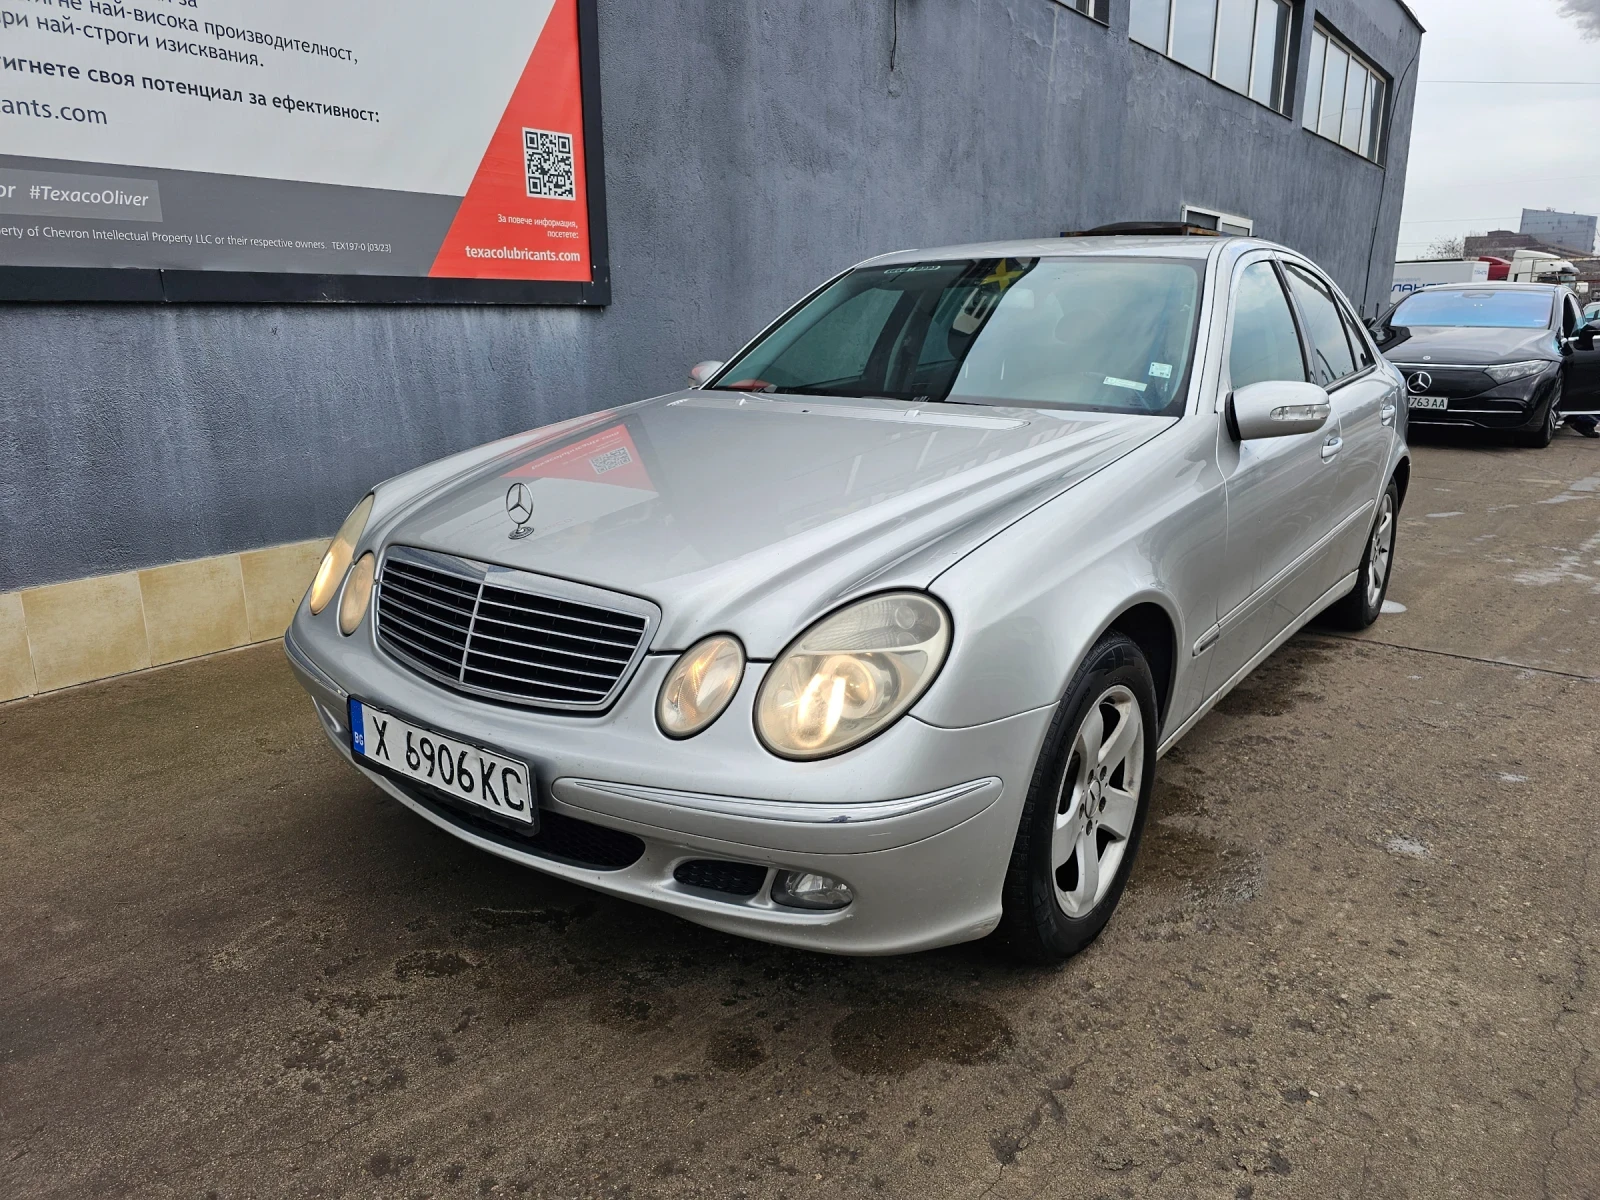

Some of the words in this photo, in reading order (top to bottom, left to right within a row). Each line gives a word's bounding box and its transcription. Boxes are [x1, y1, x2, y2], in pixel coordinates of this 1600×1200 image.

[0, 10, 29, 29] ри
[36, 14, 150, 48] най-строги
[155, 37, 264, 67] изисквания.
[89, 0, 199, 33] най-висока
[204, 21, 358, 65] производителност,
[0, 56, 81, 80] игнете
[87, 68, 135, 87] своя
[141, 76, 243, 103] потенциал
[248, 92, 267, 106] за
[272, 94, 380, 123] ефективност:
[0, 99, 108, 125] ants.com
[29, 184, 149, 207] #TexacoOliver
[497, 213, 507, 223] За
[508, 215, 533, 225] повече
[533, 218, 579, 229] информация,
[0, 225, 24, 239] erty
[27, 225, 39, 237] of
[42, 226, 90, 239] Chevron
[92, 229, 149, 241] Intellectual
[152, 232, 193, 246] Property
[195, 234, 213, 244] LLC
[214, 236, 225, 245] or
[227, 235, 248, 246] their
[250, 238, 293, 249] respective
[331, 241, 366, 251] TEX197-0
[547, 230, 579, 239] посетете:
[465, 245, 581, 262] texacolubricants.com
[354, 731, 364, 746] BG
[372, 715, 390, 761] X
